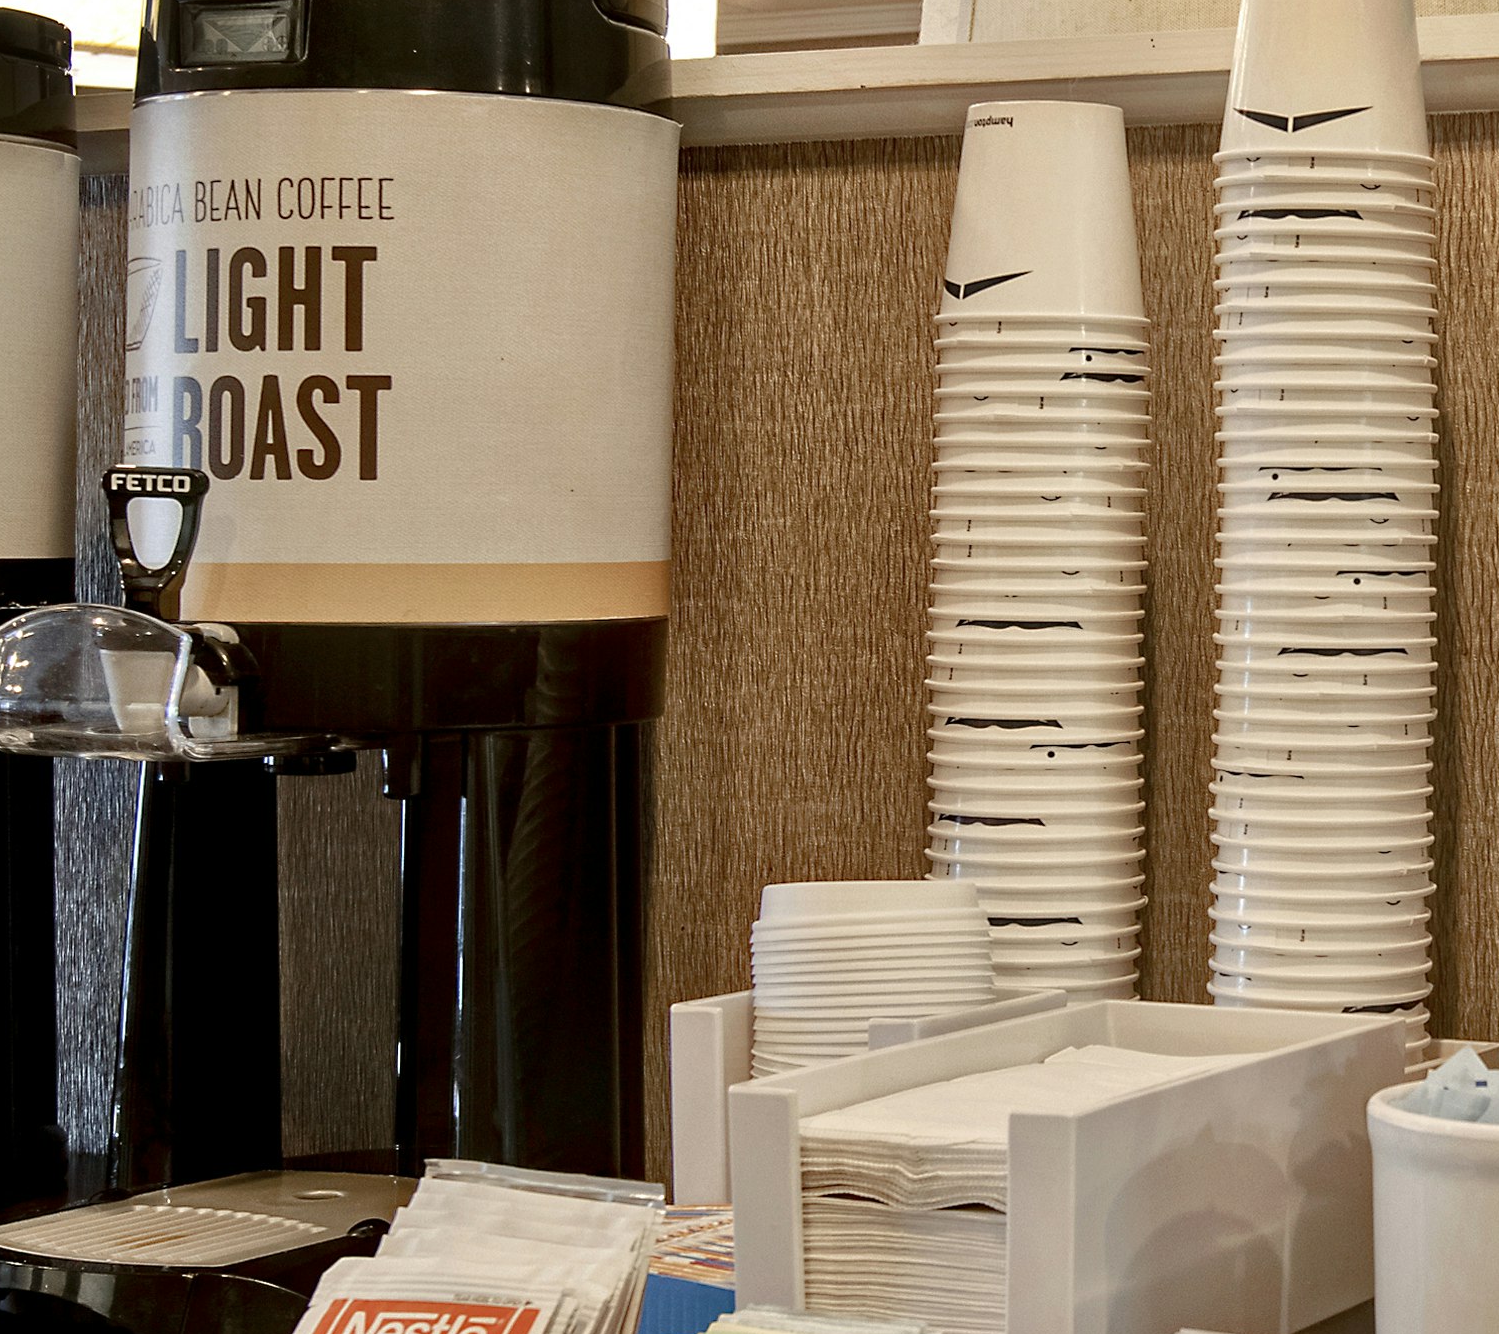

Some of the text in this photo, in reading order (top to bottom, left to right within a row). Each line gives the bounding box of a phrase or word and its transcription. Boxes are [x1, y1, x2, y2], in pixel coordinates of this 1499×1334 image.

[195, 178, 262, 223] BEAN
[277, 177, 395, 220] COFFEE
[174, 246, 378, 354] LIGHT
[172, 374, 392, 481] ROAST
[111, 473, 191, 493] FETCO
